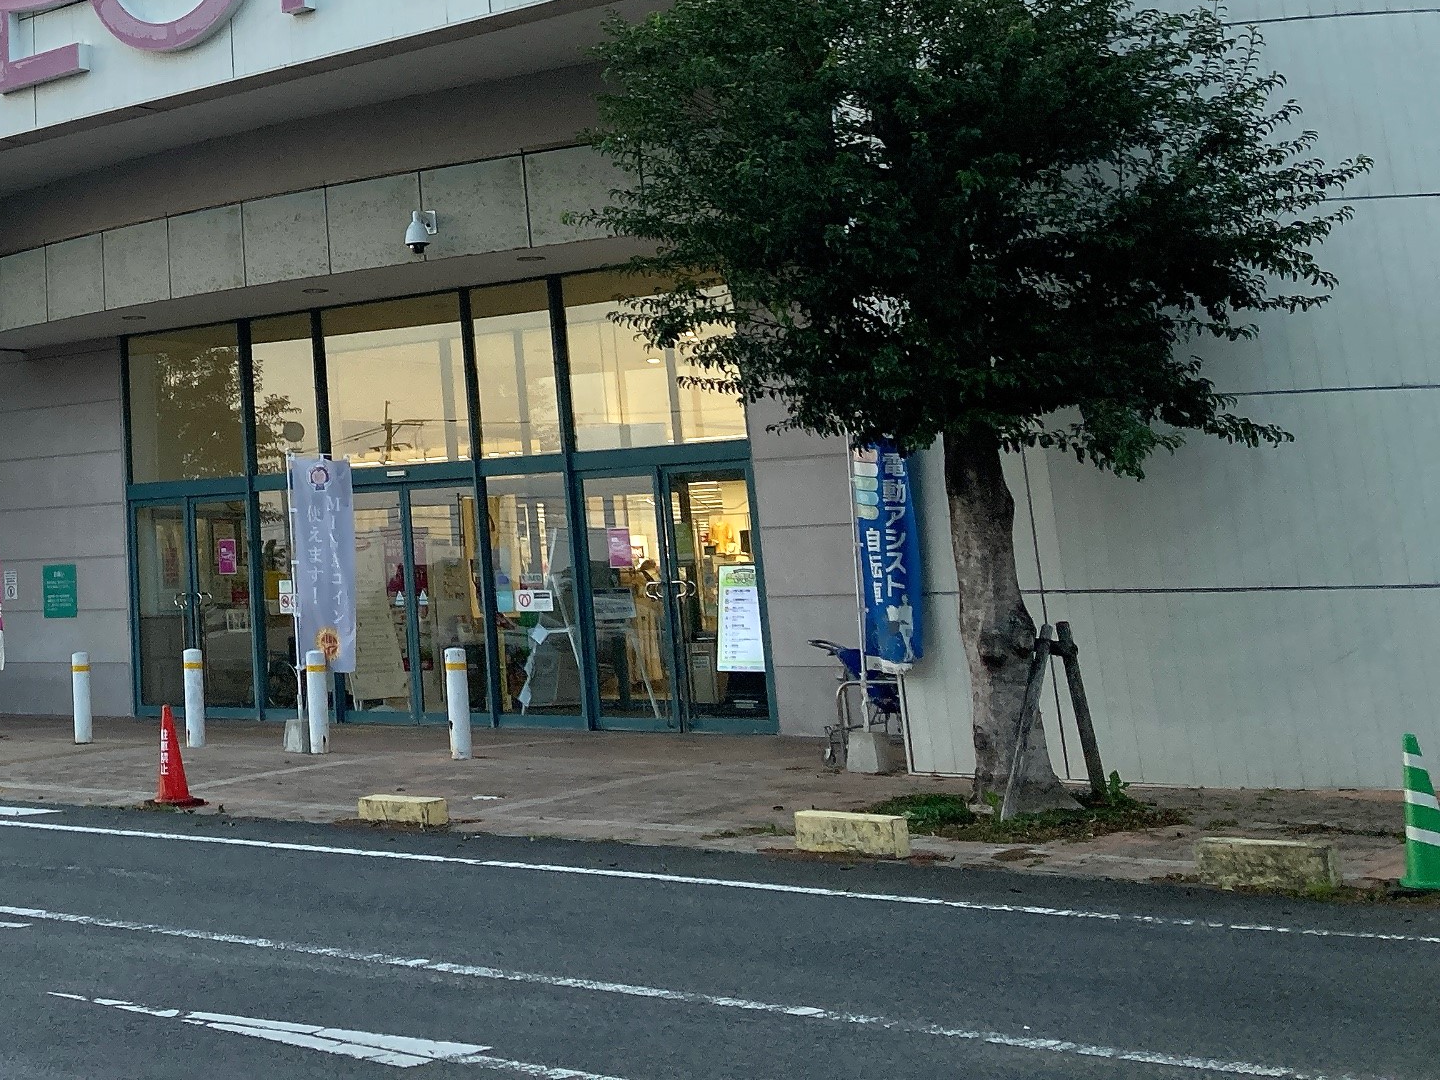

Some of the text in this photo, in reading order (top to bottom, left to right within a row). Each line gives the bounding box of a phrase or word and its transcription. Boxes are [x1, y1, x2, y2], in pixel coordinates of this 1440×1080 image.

[882, 452, 907, 597] 電動アシスト
